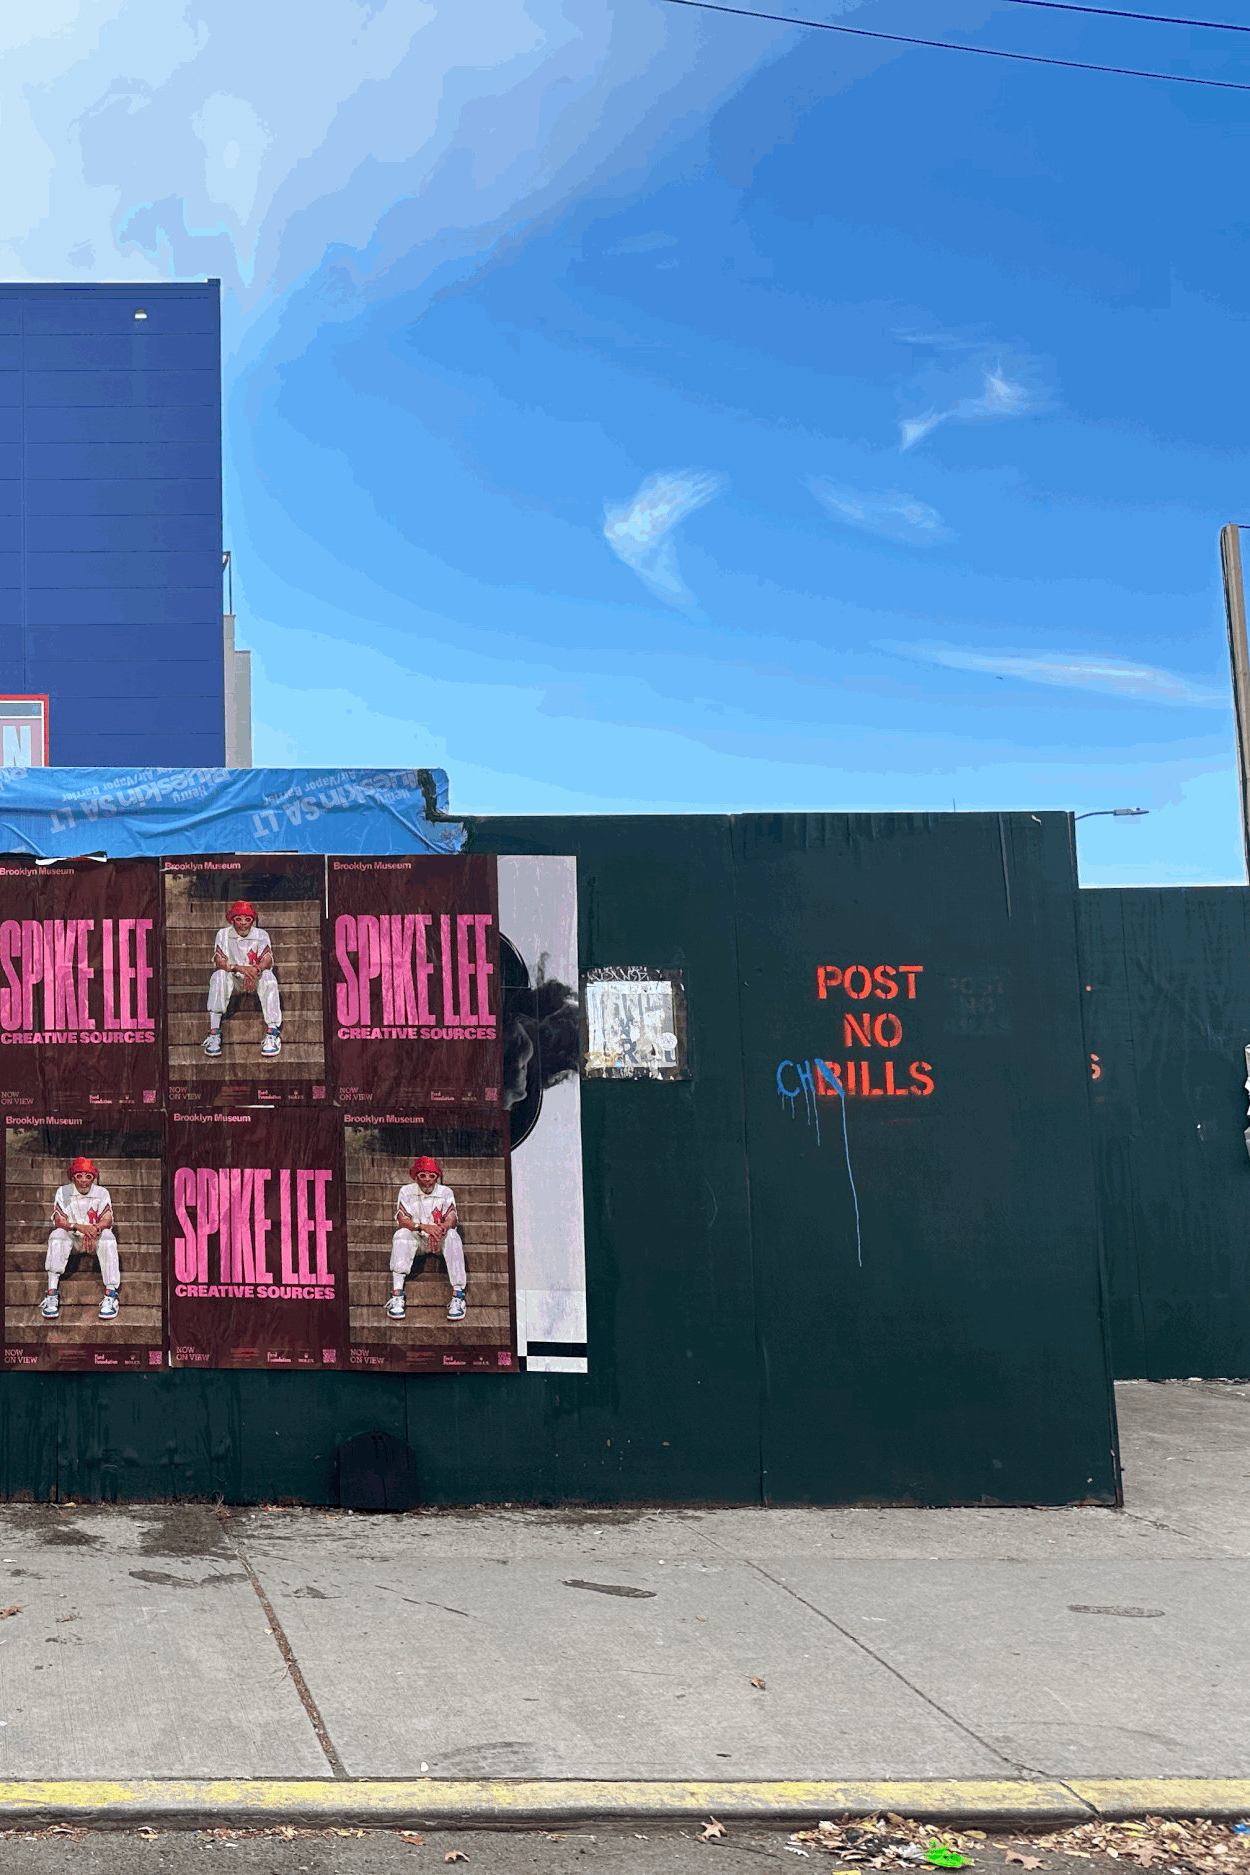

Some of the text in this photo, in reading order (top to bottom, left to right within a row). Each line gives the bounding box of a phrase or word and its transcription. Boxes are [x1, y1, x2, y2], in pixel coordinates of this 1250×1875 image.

[171, 785, 208, 804] Henry
[252, 810, 280, 838] LT
[0, 868, 37, 876] Brooklyn
[165, 862, 202, 871] Brooklyn
[334, 862, 372, 871] Brooklyn
[0, 918, 156, 1030] SPIKE LEE
[335, 914, 496, 1026] SPIKE LEE
[816, 964, 924, 1000] POST
[0, 1031, 156, 1044] CREATIVE SOURCES
[337, 1028, 496, 1040] CREATIVE SOURCES
[844, 1012, 903, 1048] NO
[816, 1061, 935, 1096] BILLS
[6, 1116, 44, 1125] Brooklyn
[174, 1114, 212, 1122] Brooklyn
[344, 1115, 423, 1124] Brooklyn Museum
[174, 1167, 336, 1285] SPIKE LEE
[175, 1284, 336, 1300] CREATIVE SOURCES
